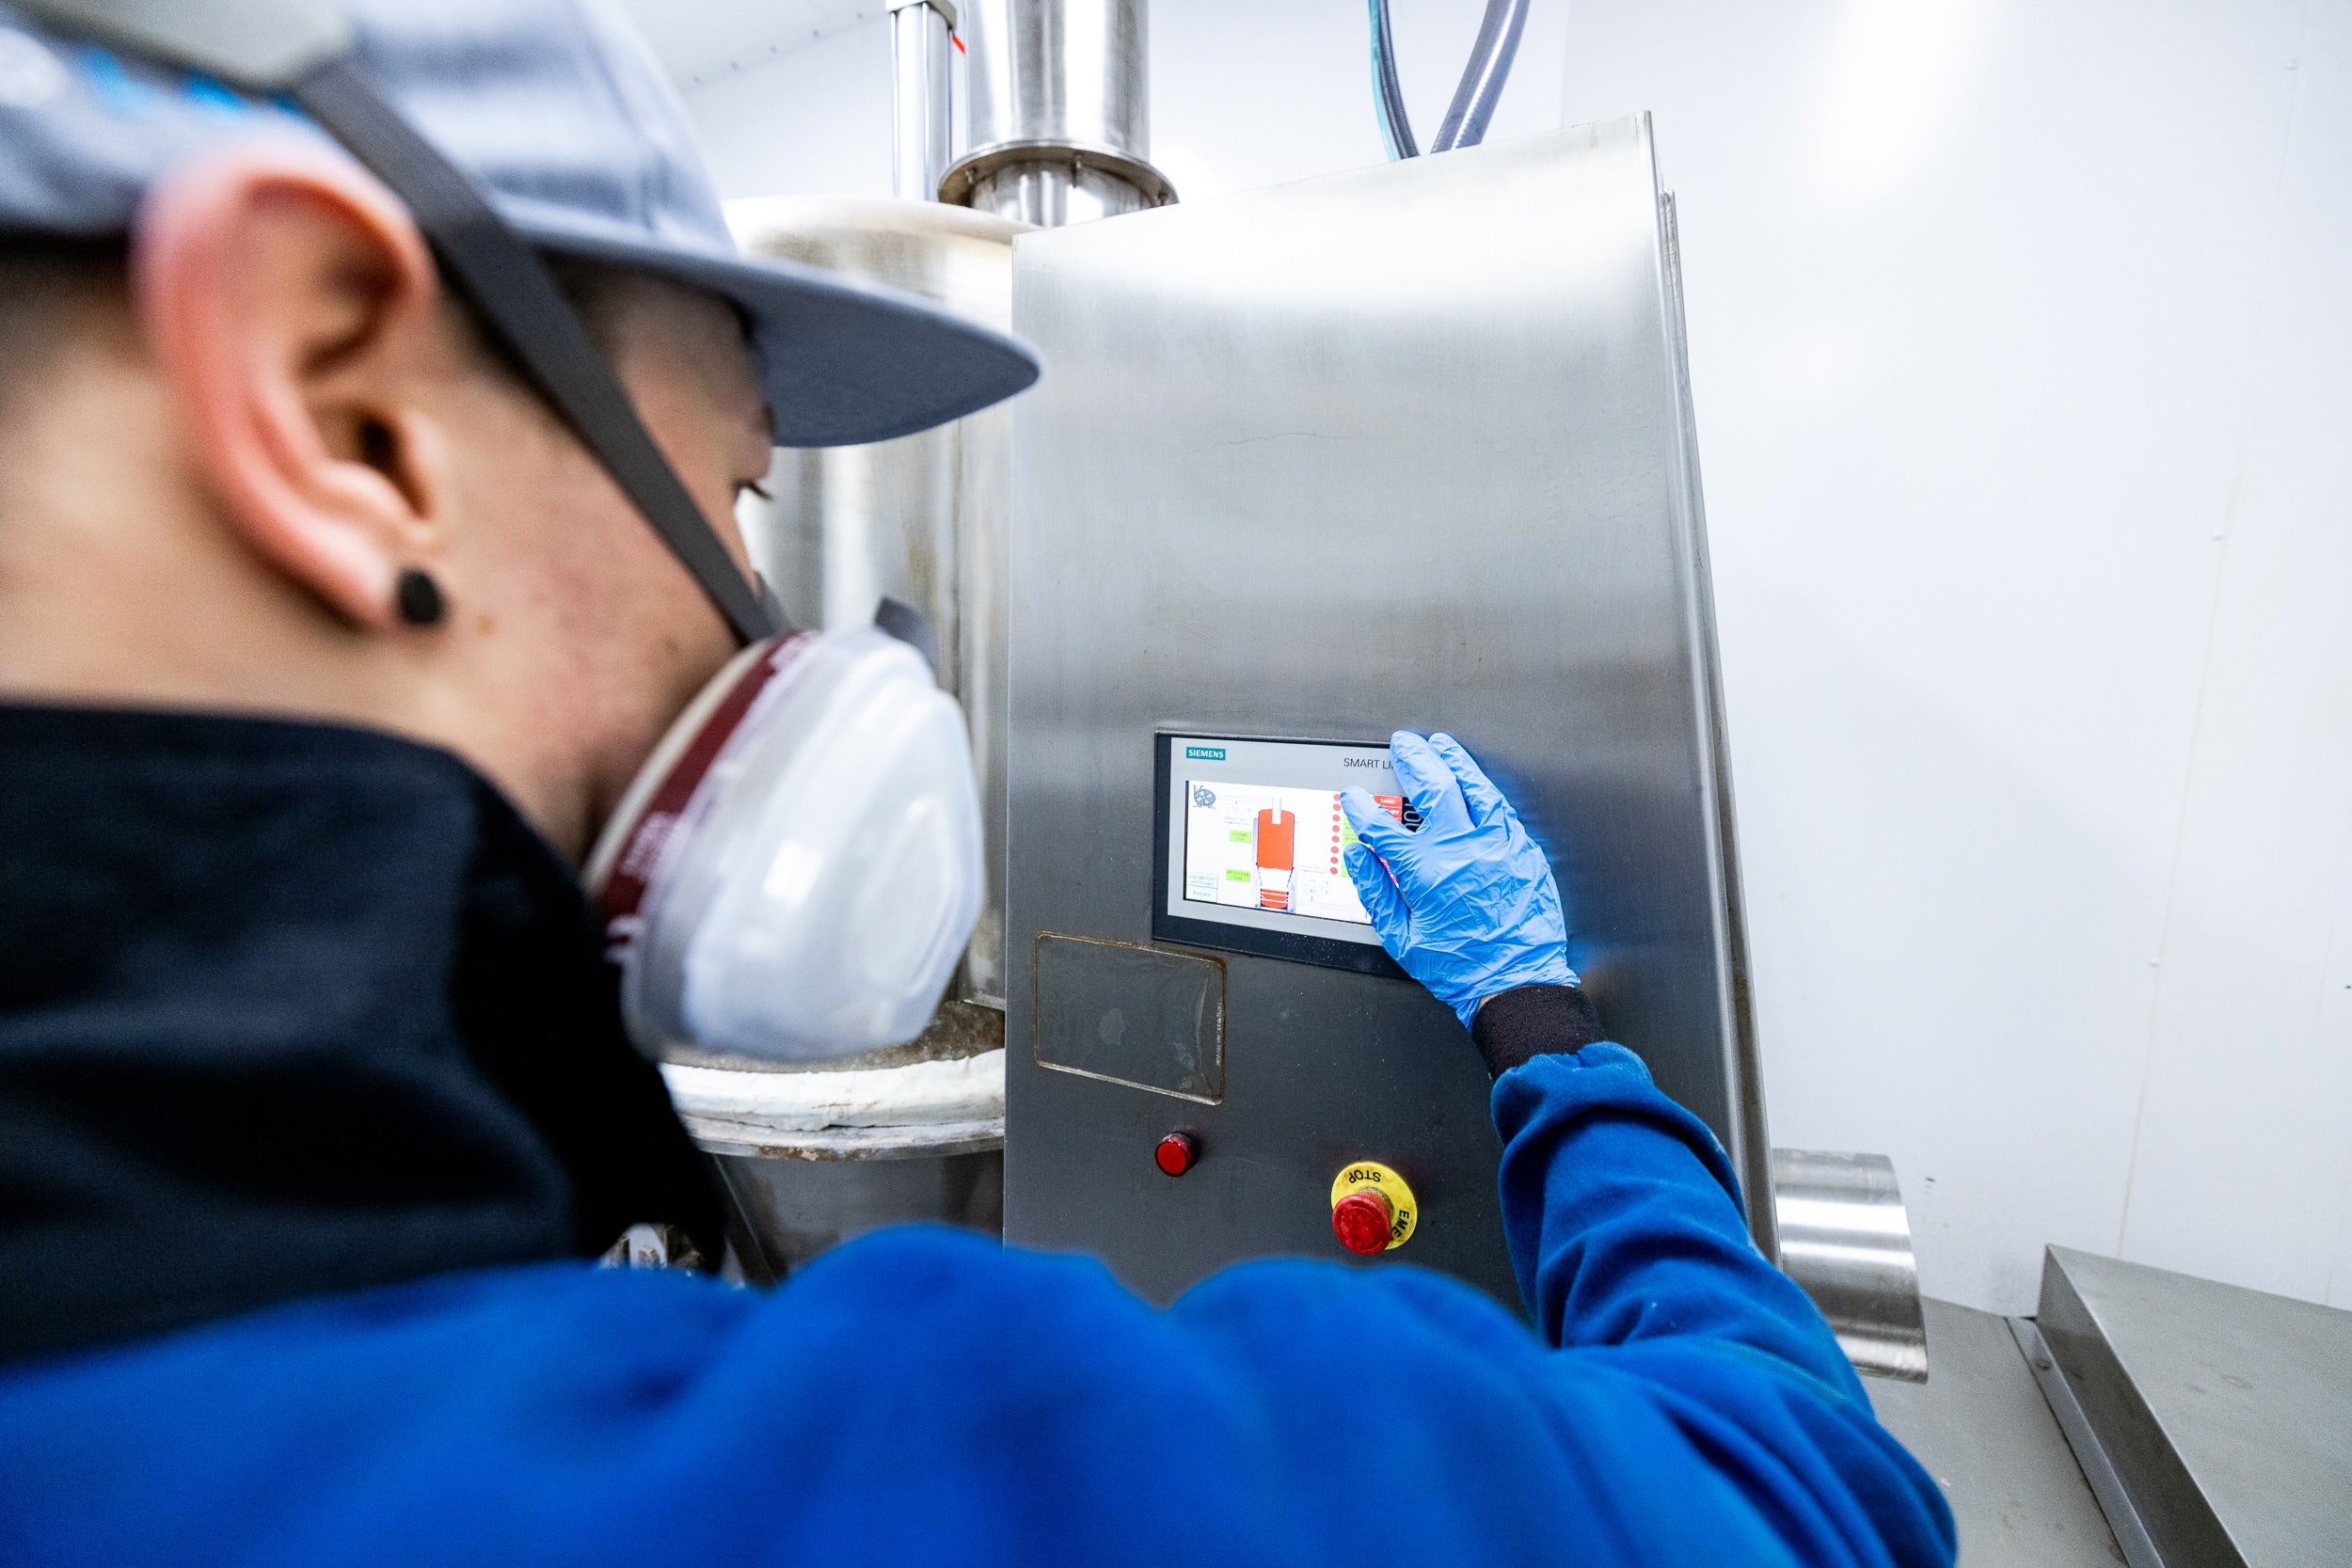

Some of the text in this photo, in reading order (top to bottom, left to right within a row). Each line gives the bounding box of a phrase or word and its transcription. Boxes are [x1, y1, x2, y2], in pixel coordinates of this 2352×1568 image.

[1188, 749, 1224, 759] SIEMENS
[1343, 757, 1394, 770] SMART LI
[1348, 1169, 1381, 1183] STOP
